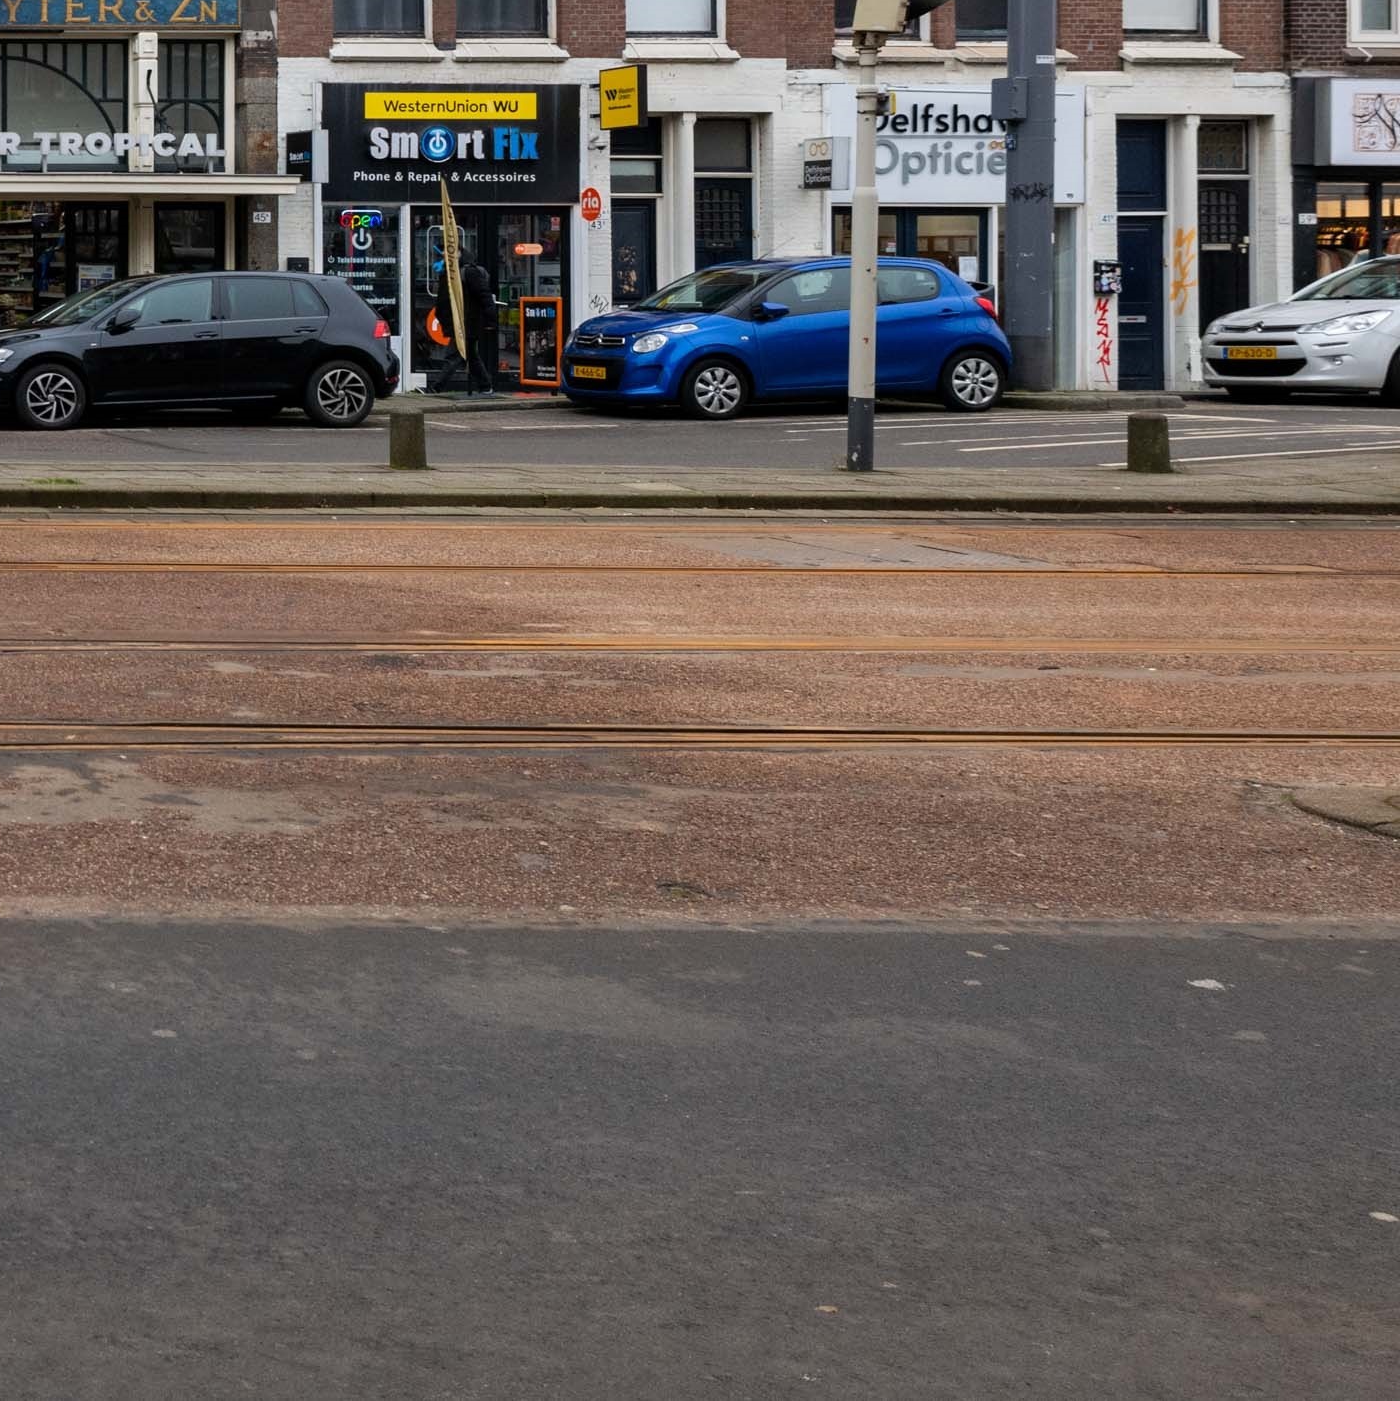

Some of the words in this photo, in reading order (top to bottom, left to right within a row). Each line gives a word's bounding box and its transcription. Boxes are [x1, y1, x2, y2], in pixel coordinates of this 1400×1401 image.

[134, 0, 156, 22] &
[493, 100, 519, 112] WU
[33, 131, 226, 158] TROPICAL
[492, 126, 540, 161] Fix
[875, 139, 1006, 186] Opticie
[353, 171, 391, 182] Phone
[394, 172, 404, 182] &
[408, 172, 447, 184] Repai
[451, 172, 460, 182] &
[464, 171, 537, 183] Accessoires
[340, 214, 381, 230] open
